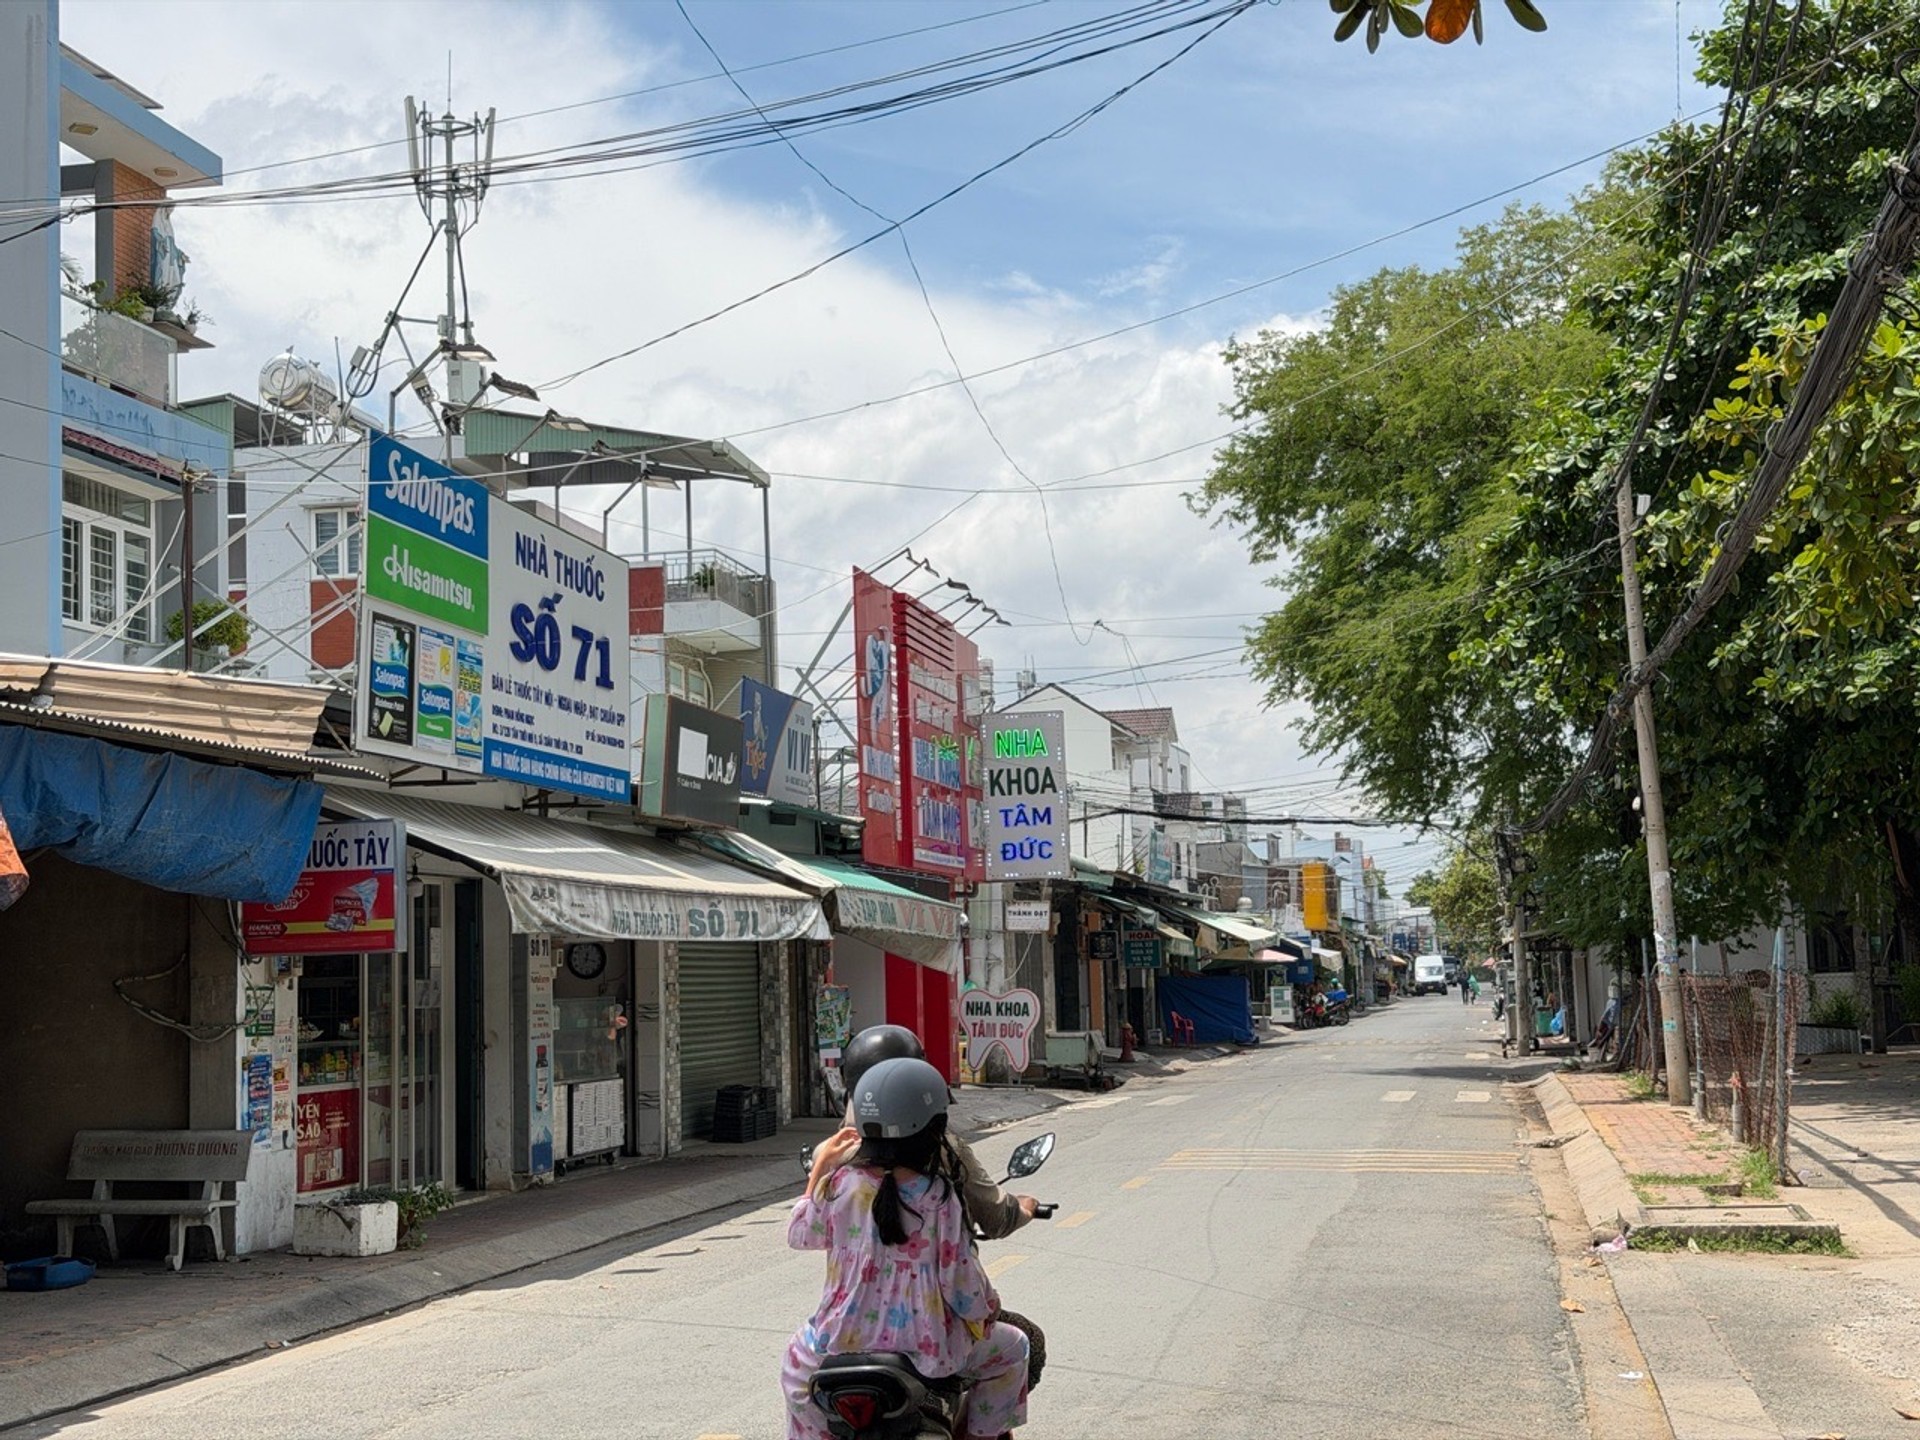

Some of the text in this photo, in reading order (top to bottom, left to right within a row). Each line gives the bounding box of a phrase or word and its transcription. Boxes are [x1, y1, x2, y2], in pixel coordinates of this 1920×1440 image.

[385, 450, 475, 535] Salonpas
[383, 544, 475, 611] Hisamitsu
[515, 531, 605, 601] NHÀ THUỐC
[509, 592, 615, 690] SỐ 71
[995, 728, 1049, 759] NHA
[990, 766, 1057, 797] KHOA
[999, 803, 1053, 828] TÂM
[354, 830, 390, 867] TÂY
[1001, 837, 1053, 861] ĐỨC
[612, 904, 631, 934] NHÀ
[633, 904, 663, 935] THUỐC
[664, 907, 681, 936] TÂY
[688, 899, 725, 937] SỐ
[966, 1001, 1030, 1017] NHA KHOA
[971, 1019, 1024, 1039] TÂM ĐỨC
[297, 1097, 320, 1120] YẾN
